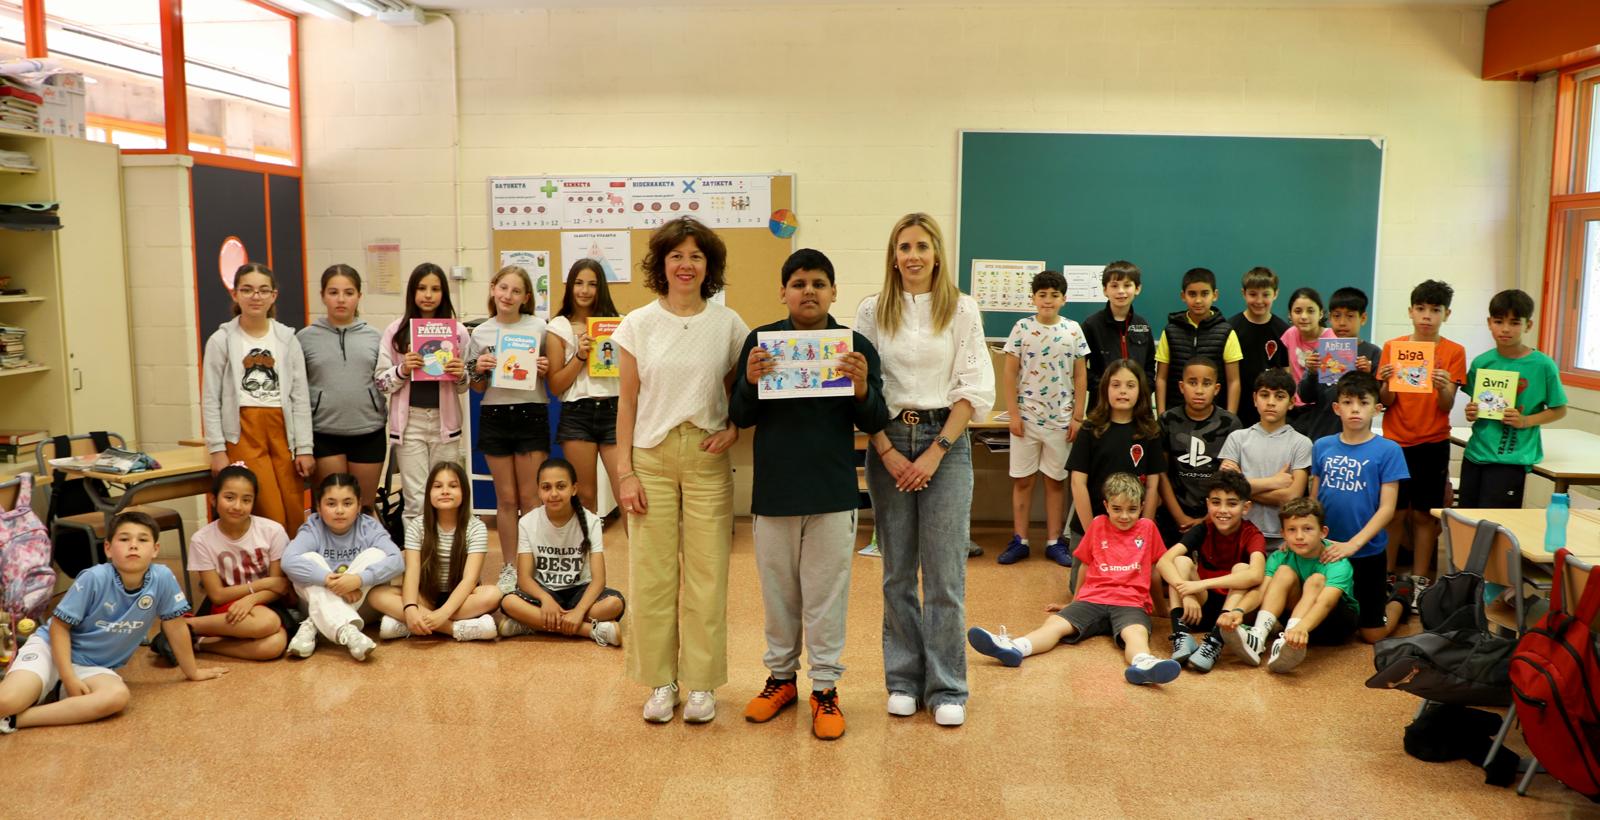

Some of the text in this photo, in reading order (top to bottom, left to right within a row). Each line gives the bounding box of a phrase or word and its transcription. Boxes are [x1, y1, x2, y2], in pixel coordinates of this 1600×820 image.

[417, 326, 452, 334] PATATA
[1398, 349, 1424, 361] biga
[1482, 377, 1509, 389] avni
[1323, 455, 1370, 477] READY
[1330, 466, 1355, 481] FOR
[323, 549, 335, 559] BE
[537, 545, 583, 555] WORLD'S
[536, 556, 583, 571] BEST
